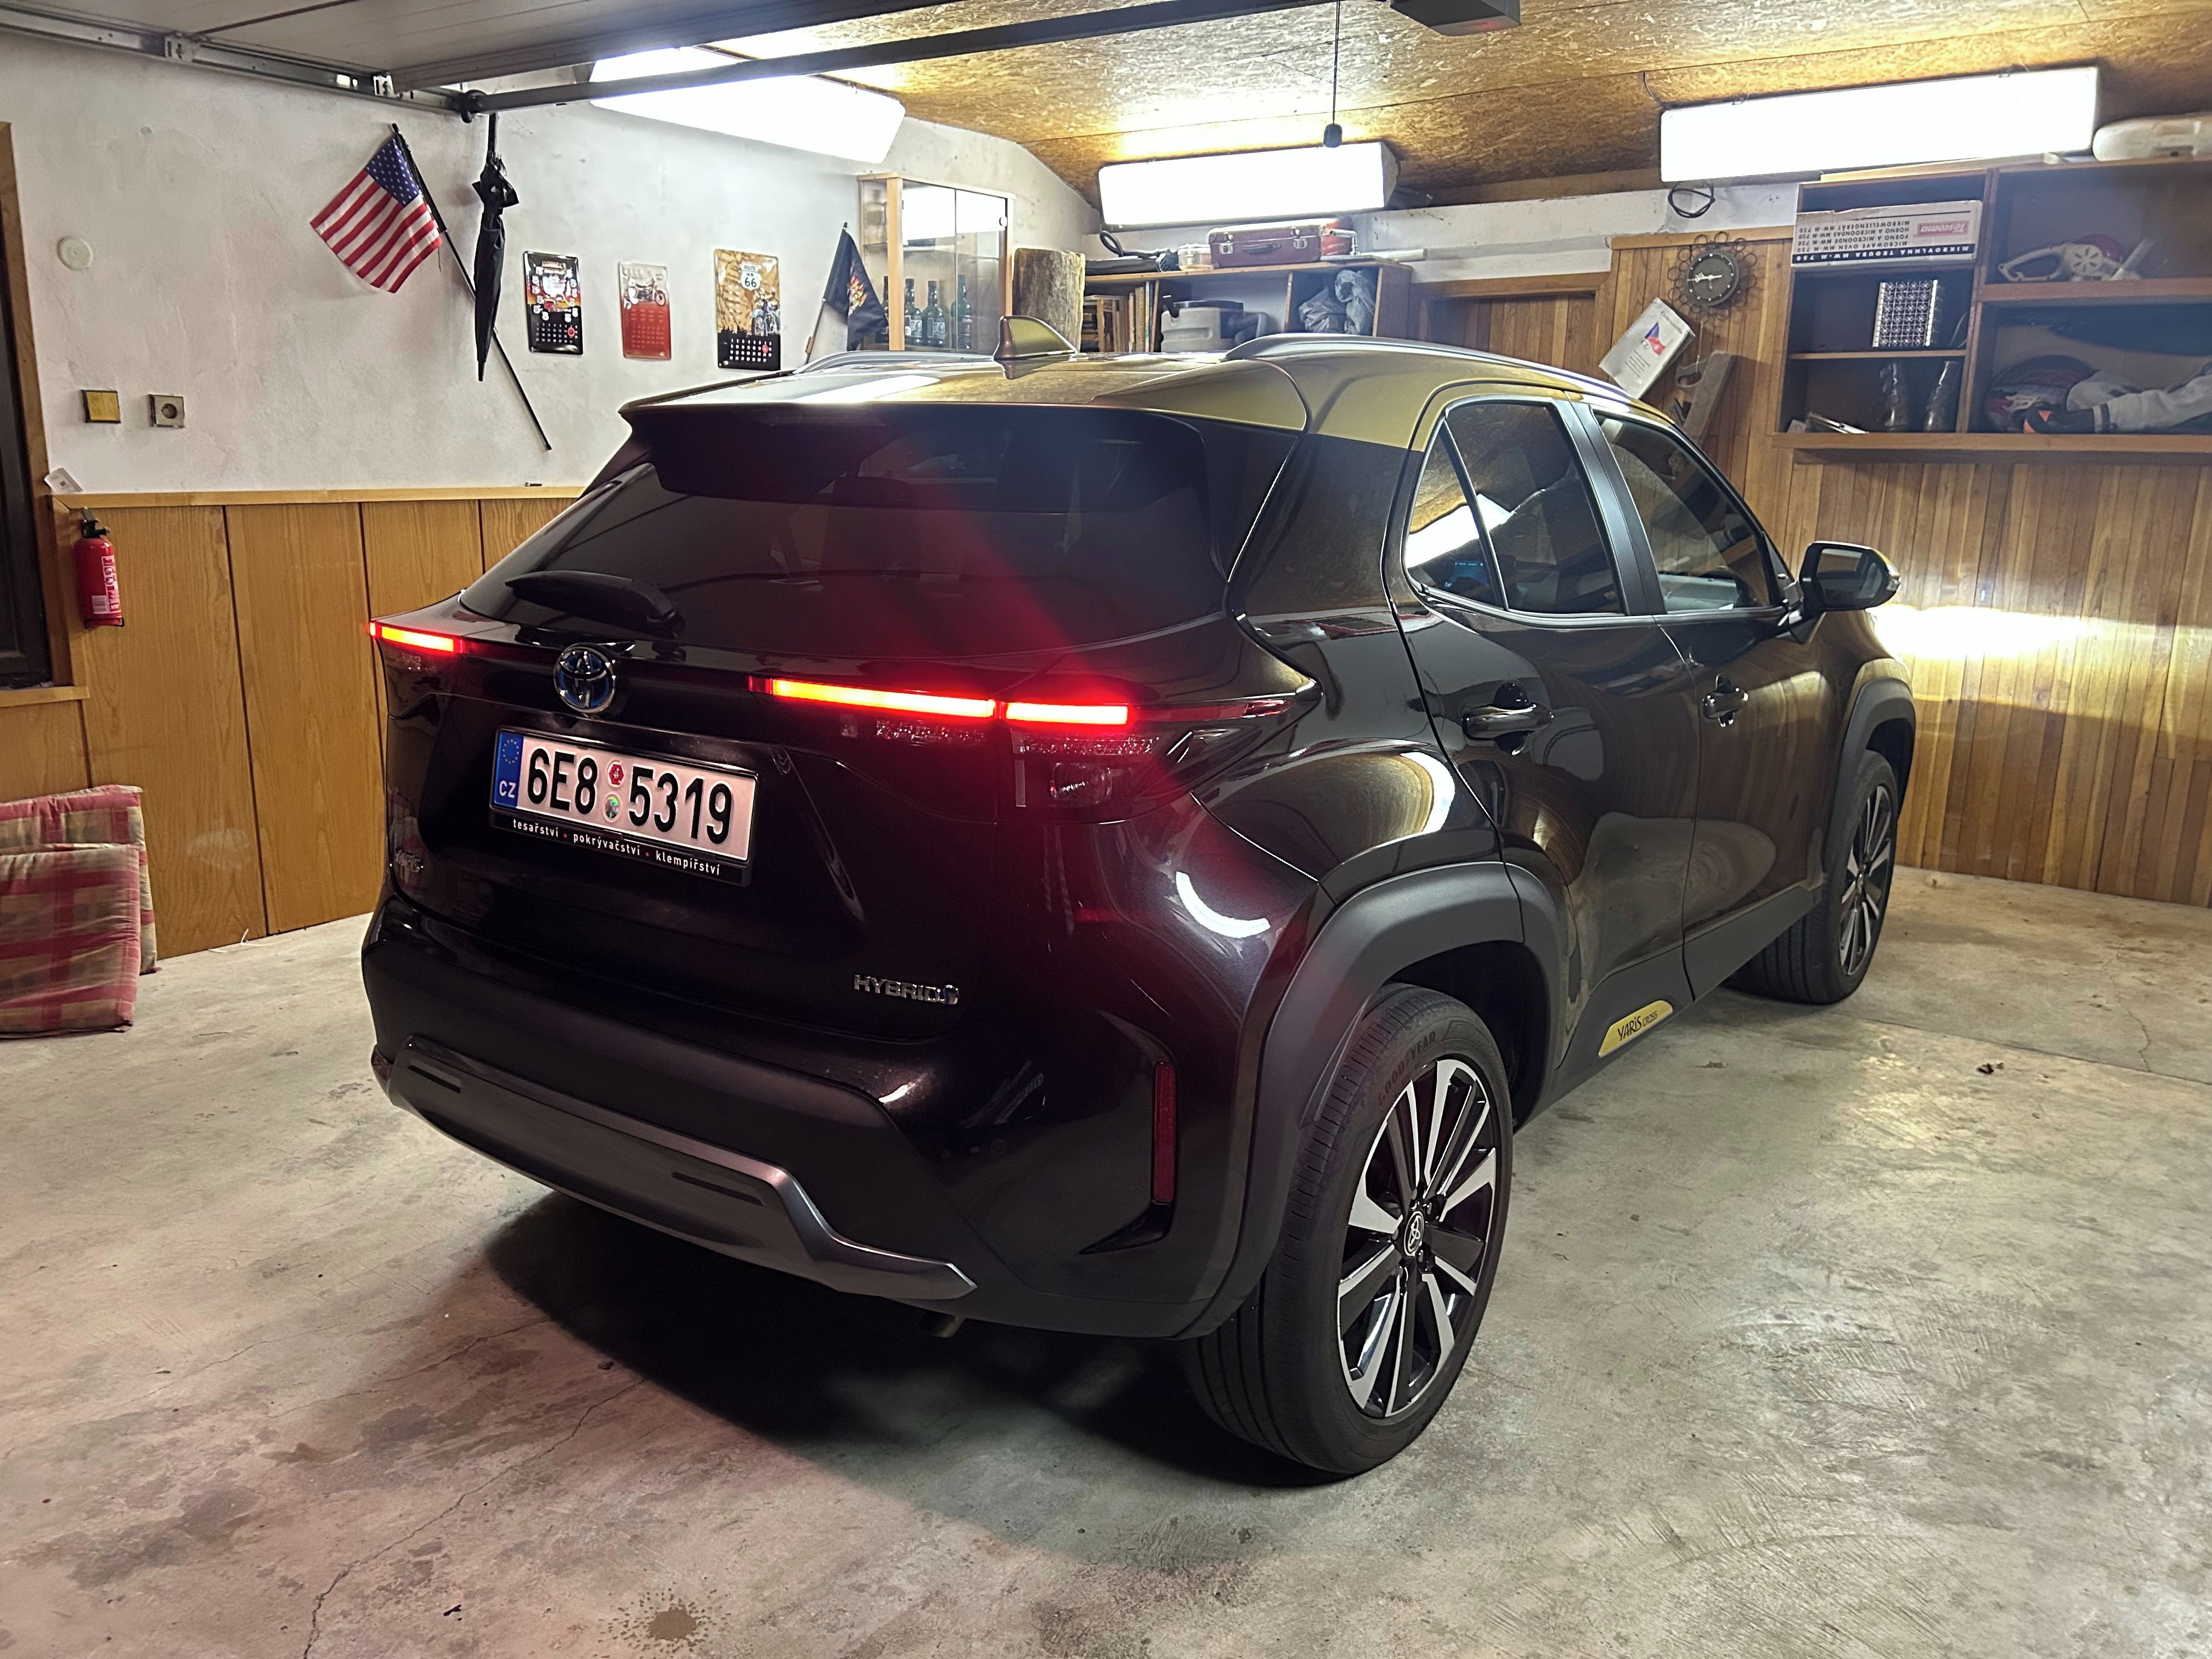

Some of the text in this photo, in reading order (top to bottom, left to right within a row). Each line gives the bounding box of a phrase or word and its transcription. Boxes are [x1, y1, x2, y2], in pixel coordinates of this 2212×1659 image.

[1900, 246, 1969, 256] MIKROVLNNÁ
[744, 277, 757, 287] 66
[499, 780, 516, 799] CZ
[527, 748, 732, 844] 6E8 5319
[514, 819, 720, 876] tesařství pokrývačství klempířství
[854, 974, 941, 1003] HYBRID
[1378, 1031, 1436, 1106] GOODYEAR
